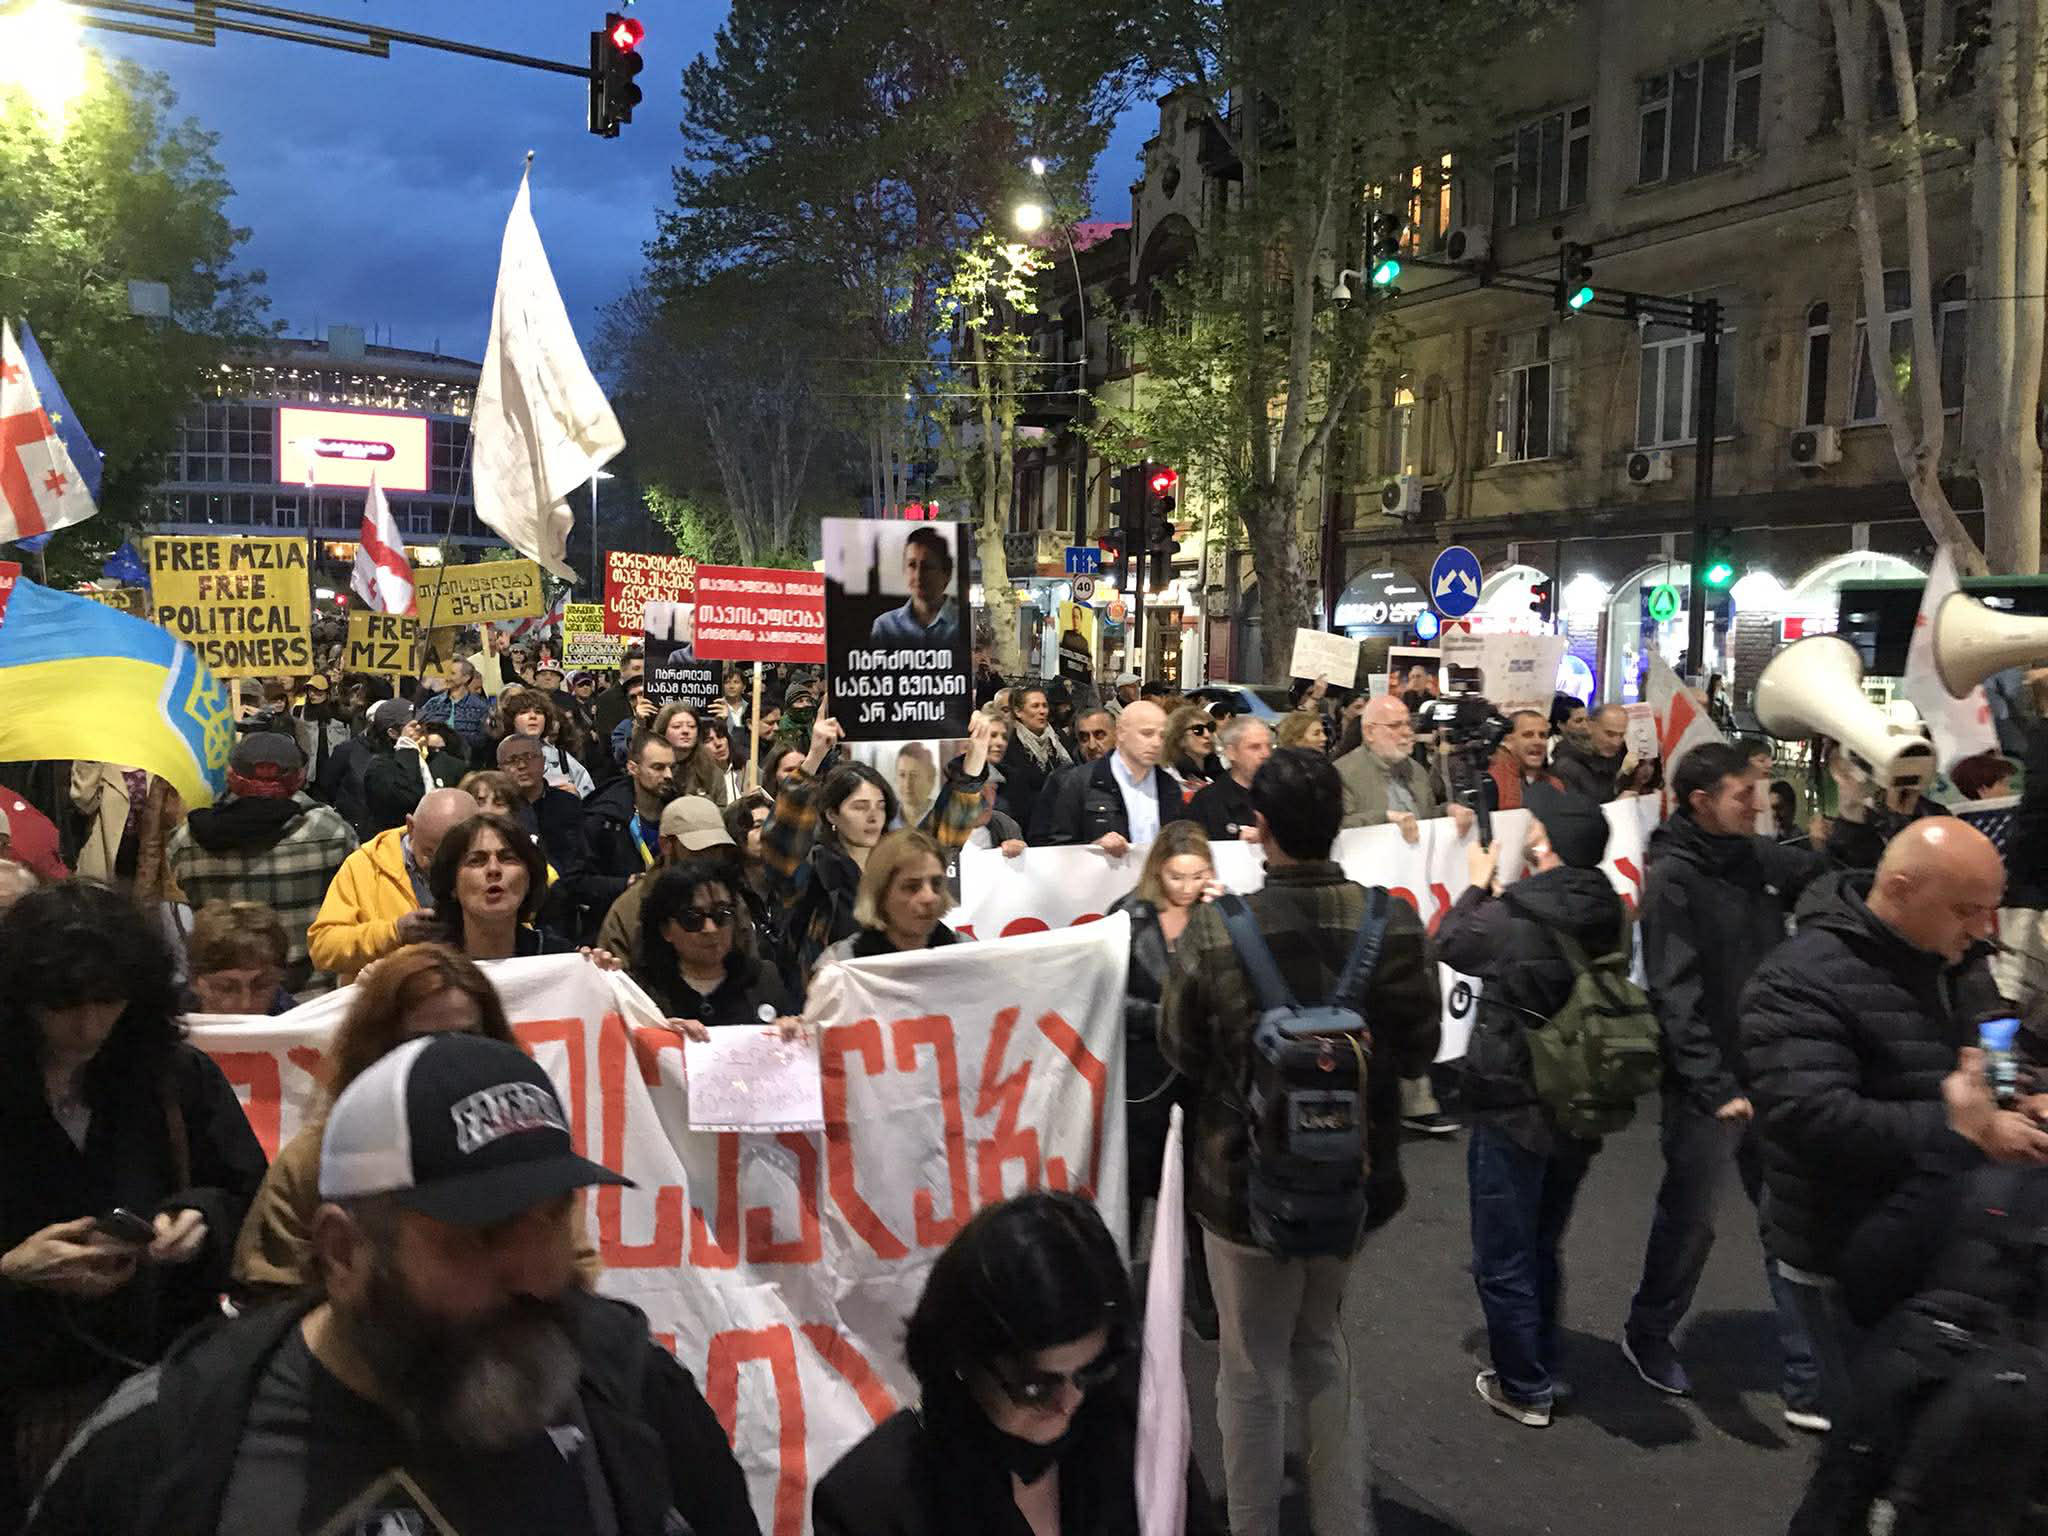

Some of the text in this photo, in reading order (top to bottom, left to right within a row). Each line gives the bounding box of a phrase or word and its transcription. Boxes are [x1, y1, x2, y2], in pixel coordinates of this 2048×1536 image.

[155, 541, 306, 571] FREE MZIA
[1077, 583, 1091, 592] 40
[159, 605, 301, 634] POLITICAL
[699, 604, 824, 628] თავისუფლება
[184, 637, 309, 668] ISONERS
[351, 641, 444, 673] MZIA
[848, 649, 953, 671] იბრძოლეთ
[655, 668, 712, 681] იბრძოლეთ
[835, 674, 967, 697] სანამ გვიანი
[647, 682, 719, 695] სანამ გვიანი
[859, 700, 945, 723] არ არის!
